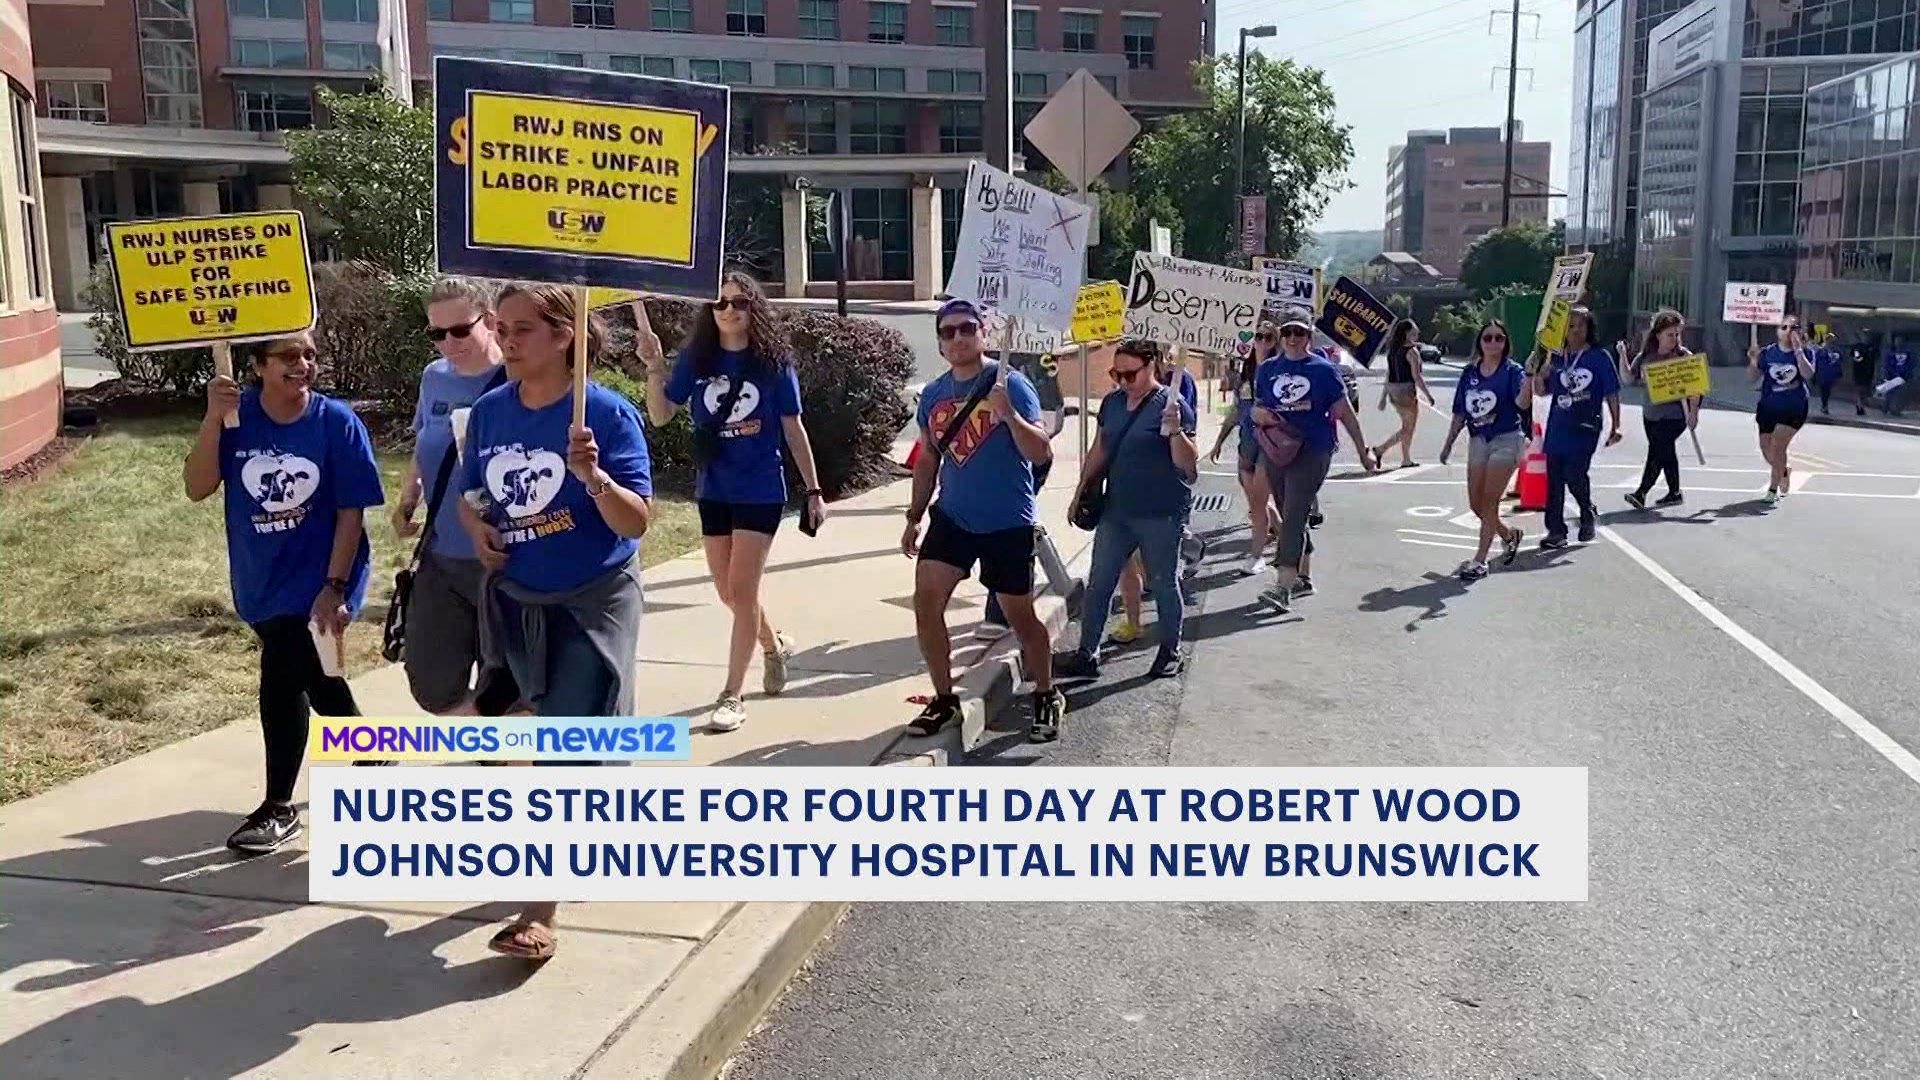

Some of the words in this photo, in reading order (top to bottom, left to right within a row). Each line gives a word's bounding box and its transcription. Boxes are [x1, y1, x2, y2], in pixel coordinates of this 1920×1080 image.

[513, 114, 564, 136] RWJ
[572, 120, 621, 142] RNS
[630, 125, 663, 146] ON
[480, 141, 569, 166] STRIKE
[592, 152, 680, 178] UNFAIR
[481, 170, 559, 193] LABOR
[565, 178, 678, 205] PRACTICE
[121, 232, 165, 249] RWJ
[173, 225, 256, 246] NURSES
[263, 223, 292, 238] ON
[147, 249, 186, 267] ULP
[193, 244, 268, 263] STRIKE
[191, 265, 231, 282] FOR
[135, 286, 188, 306] SAFE
[193, 279, 292, 301] STAFFING
[1128, 269, 1254, 327] Deserve
[1124, 310, 1160, 342] Safe
[1329, 287, 1390, 333] SOLIDARITY
